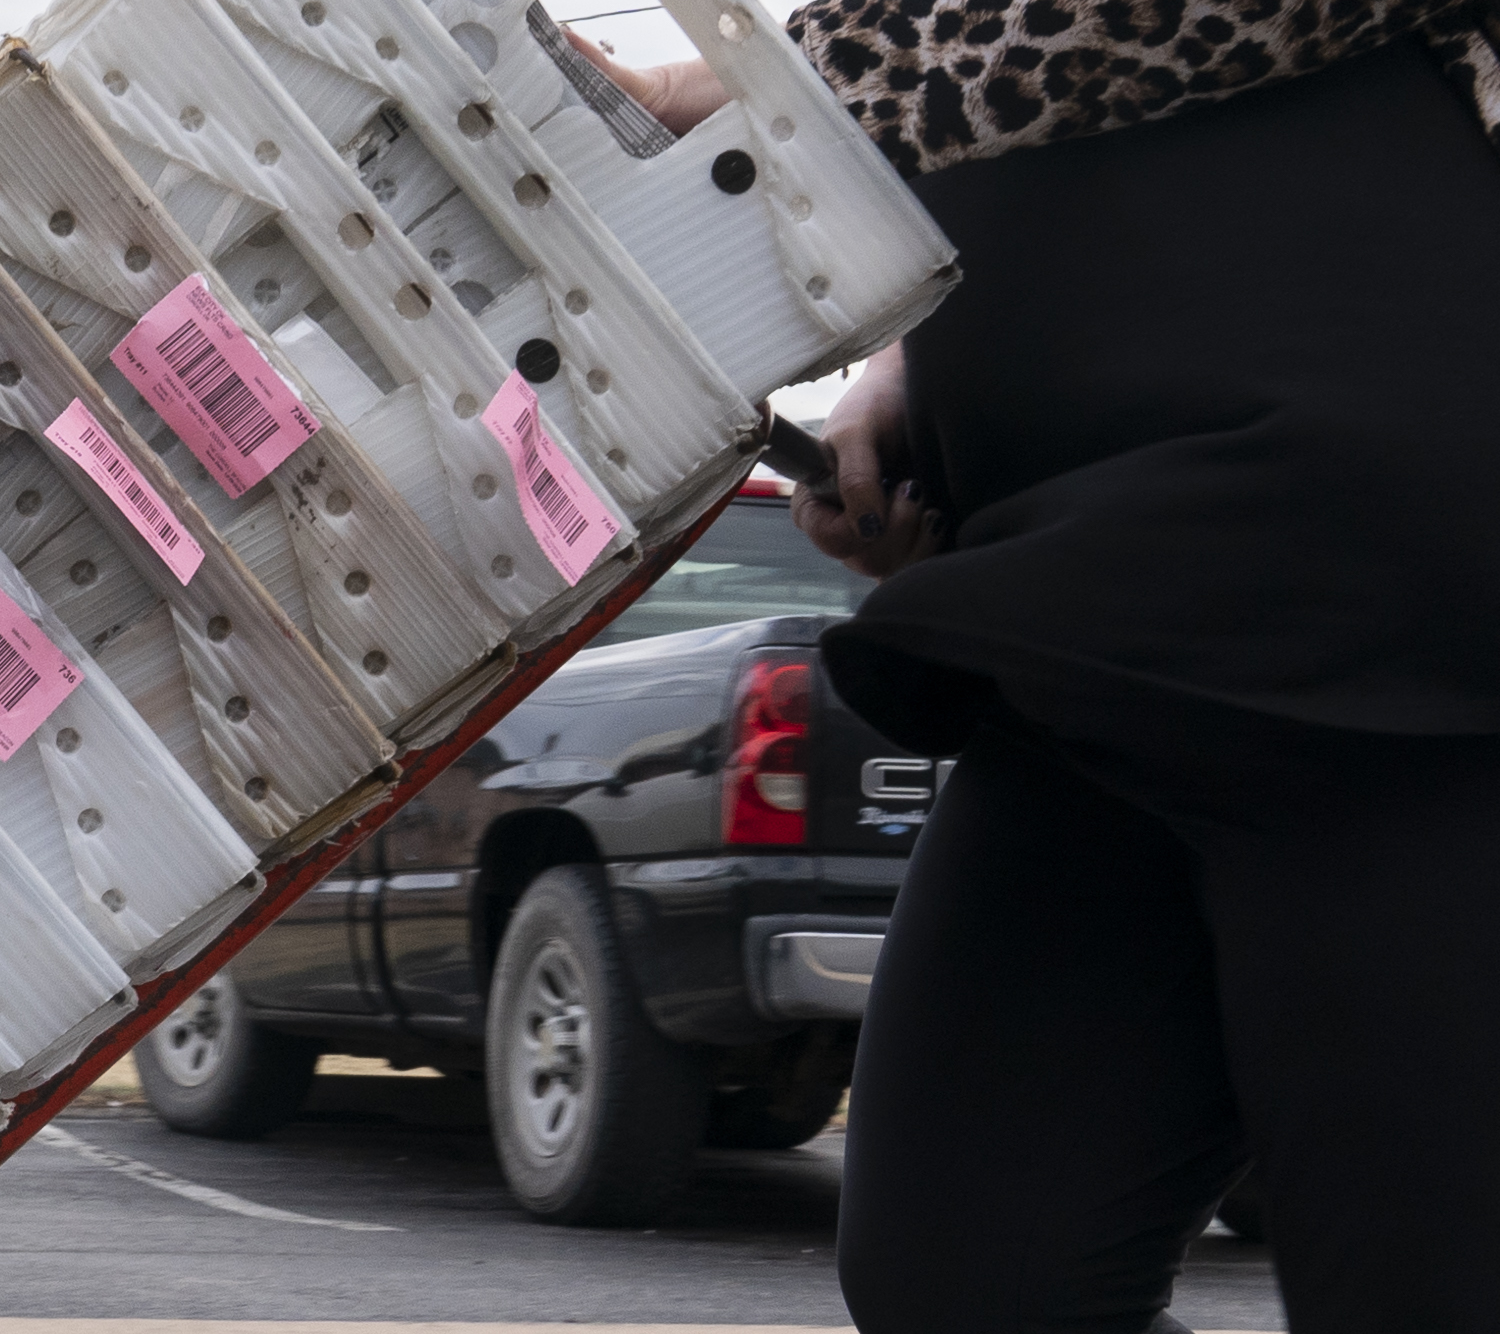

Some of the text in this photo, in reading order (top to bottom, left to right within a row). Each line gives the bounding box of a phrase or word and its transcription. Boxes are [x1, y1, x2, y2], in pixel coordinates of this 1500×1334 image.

[191, 290, 205, 307] NEWS
[205, 307, 217, 321] FLTS
[205, 297, 217, 310] CITY
[215, 309, 225, 320] OK
[122, 347, 147, 375] Tray #11
[289, 405, 315, 435] 73644
[58, 664, 76, 684] 736
